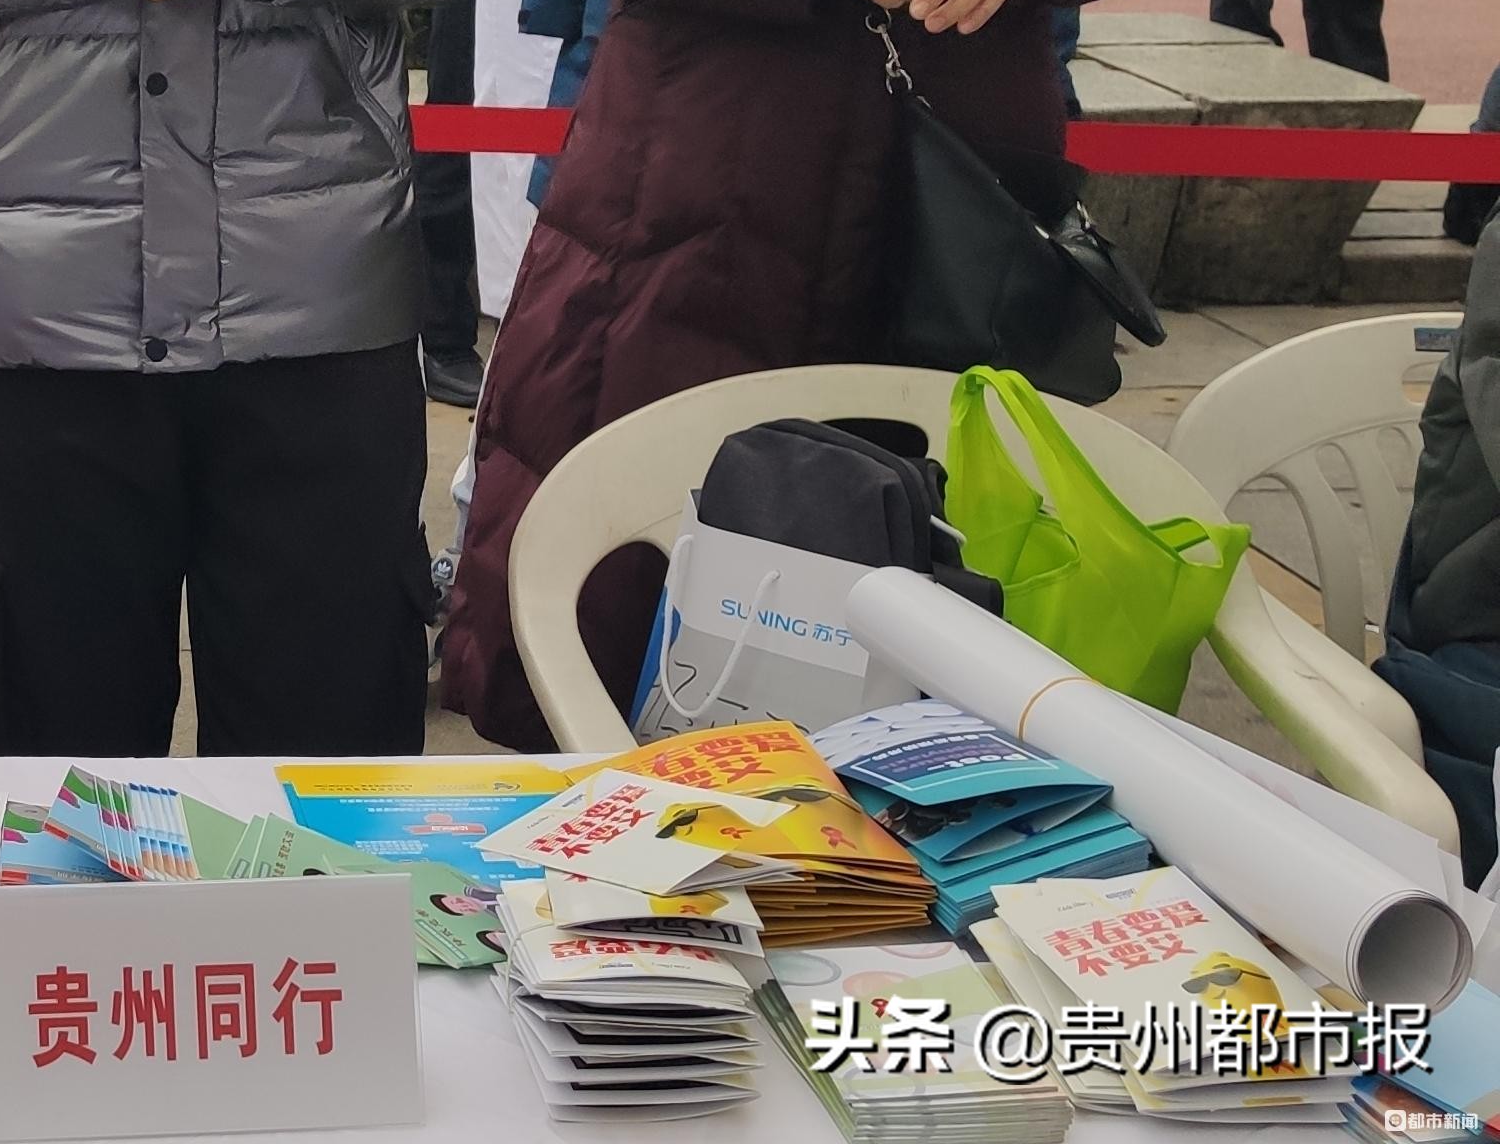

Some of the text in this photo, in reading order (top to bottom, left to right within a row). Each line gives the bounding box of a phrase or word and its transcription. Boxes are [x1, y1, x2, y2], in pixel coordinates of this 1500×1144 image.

[720, 600, 808, 637] SUNING
[28, 957, 343, 1068] 贵州同行
